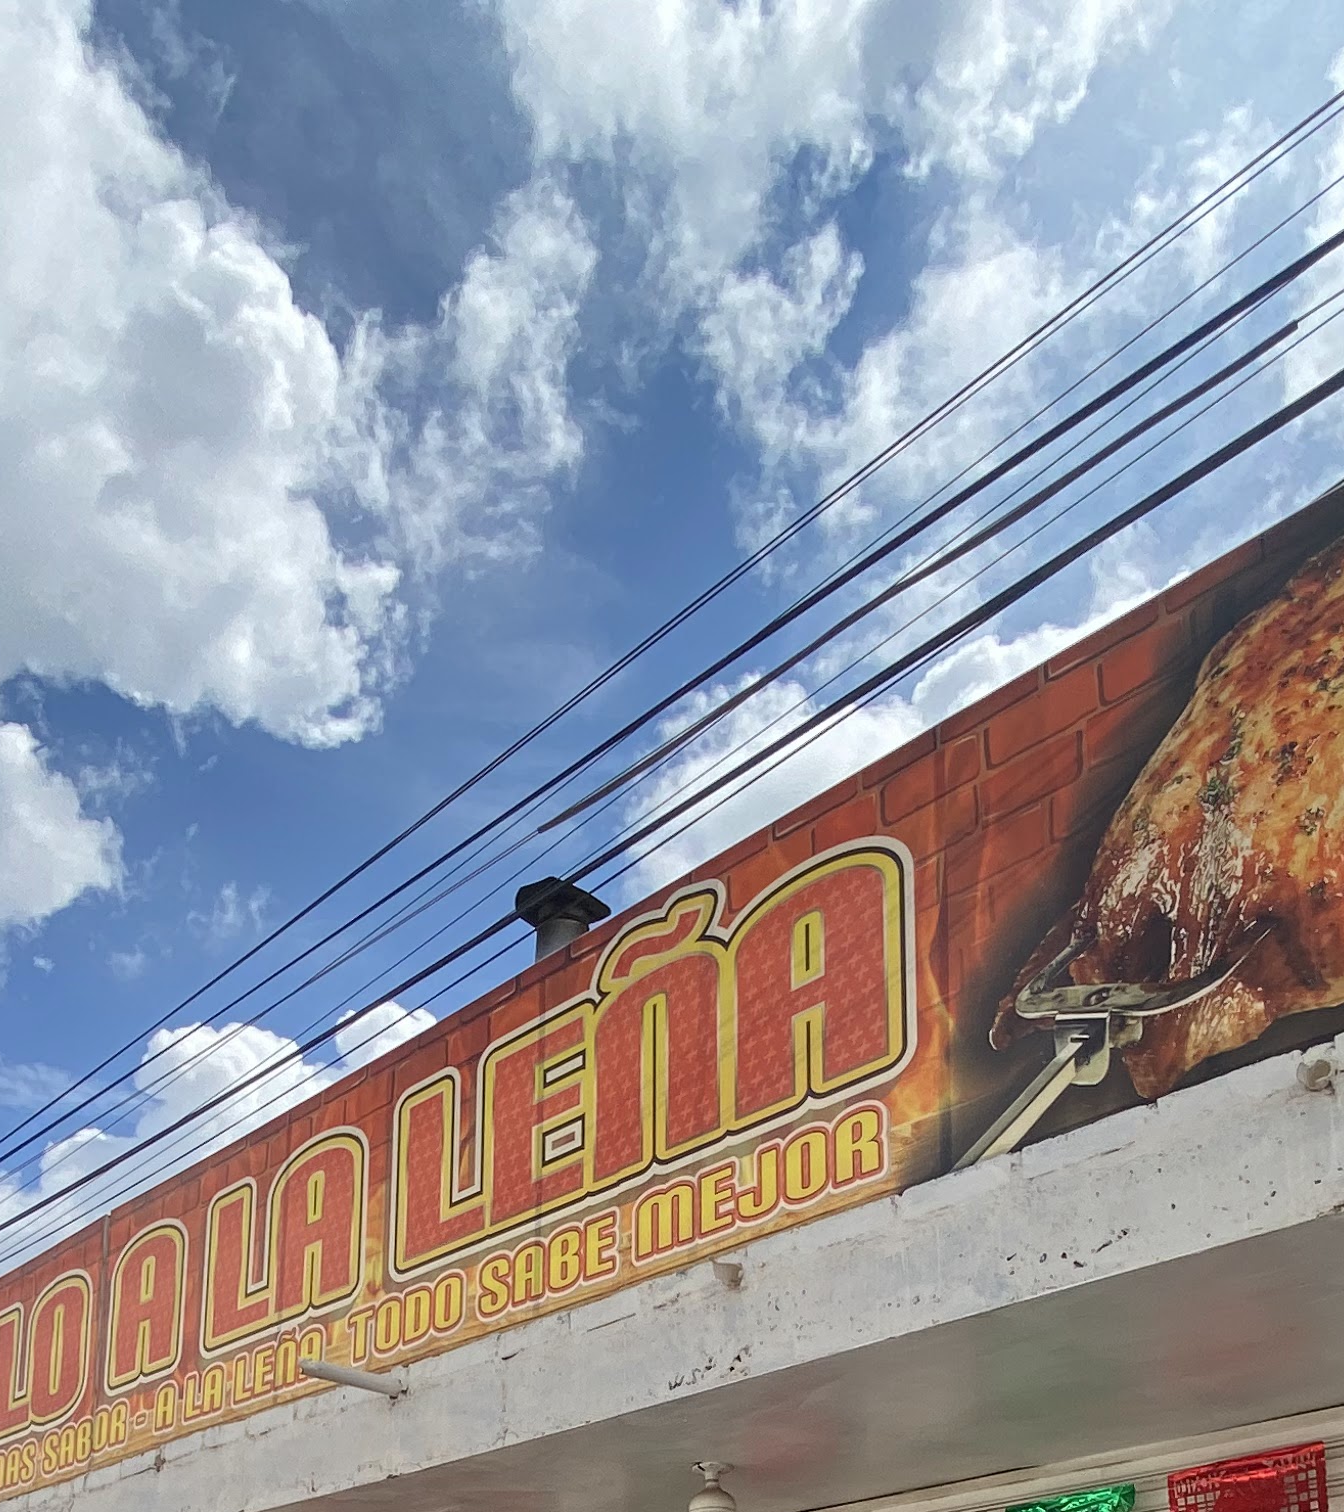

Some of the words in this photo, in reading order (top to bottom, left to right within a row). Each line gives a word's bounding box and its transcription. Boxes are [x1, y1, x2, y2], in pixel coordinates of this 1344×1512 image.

[42, 1398, 128, 1474] SABOR
[154, 1379, 180, 1433] A
[183, 1363, 226, 1424] LA
[232, 1325, 327, 1406] LEÑA
[347, 1270, 467, 1366] TODO
[477, 1203, 620, 1322] SABE
[631, 1100, 890, 1267] MEJOR
[105, 1218, 189, 1396] A
[199, 1125, 370, 1359] LA
[389, 836, 916, 1282] LEÑA
